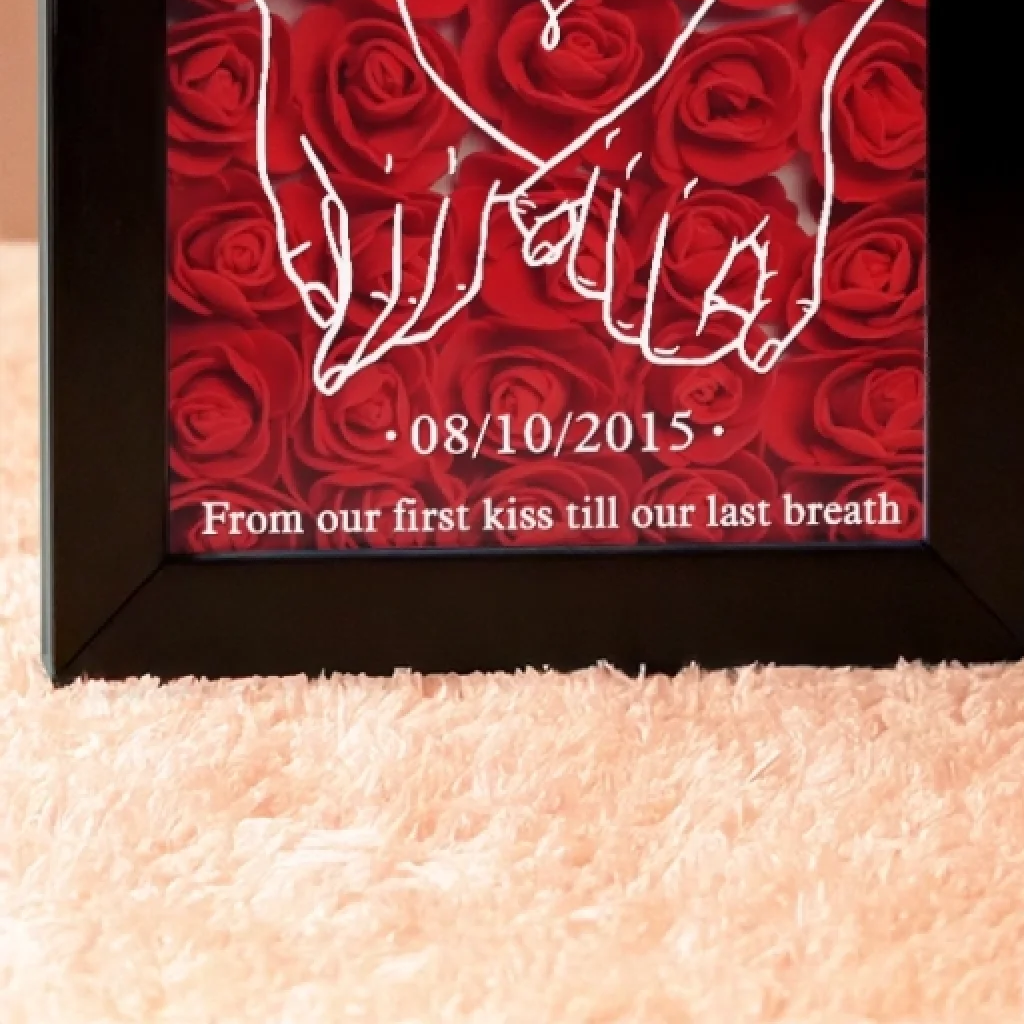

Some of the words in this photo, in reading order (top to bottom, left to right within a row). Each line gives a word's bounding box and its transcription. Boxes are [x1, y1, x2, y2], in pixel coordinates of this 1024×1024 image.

[410, 409, 696, 459] 08/10/2015
[200, 501, 305, 536] From
[316, 508, 381, 534] our
[392, 497, 471, 534] first
[482, 497, 554, 532] kiss
[565, 495, 619, 530] till
[631, 503, 696, 530] our
[706, 493, 772, 528] last
[783, 491, 902, 526] breath
